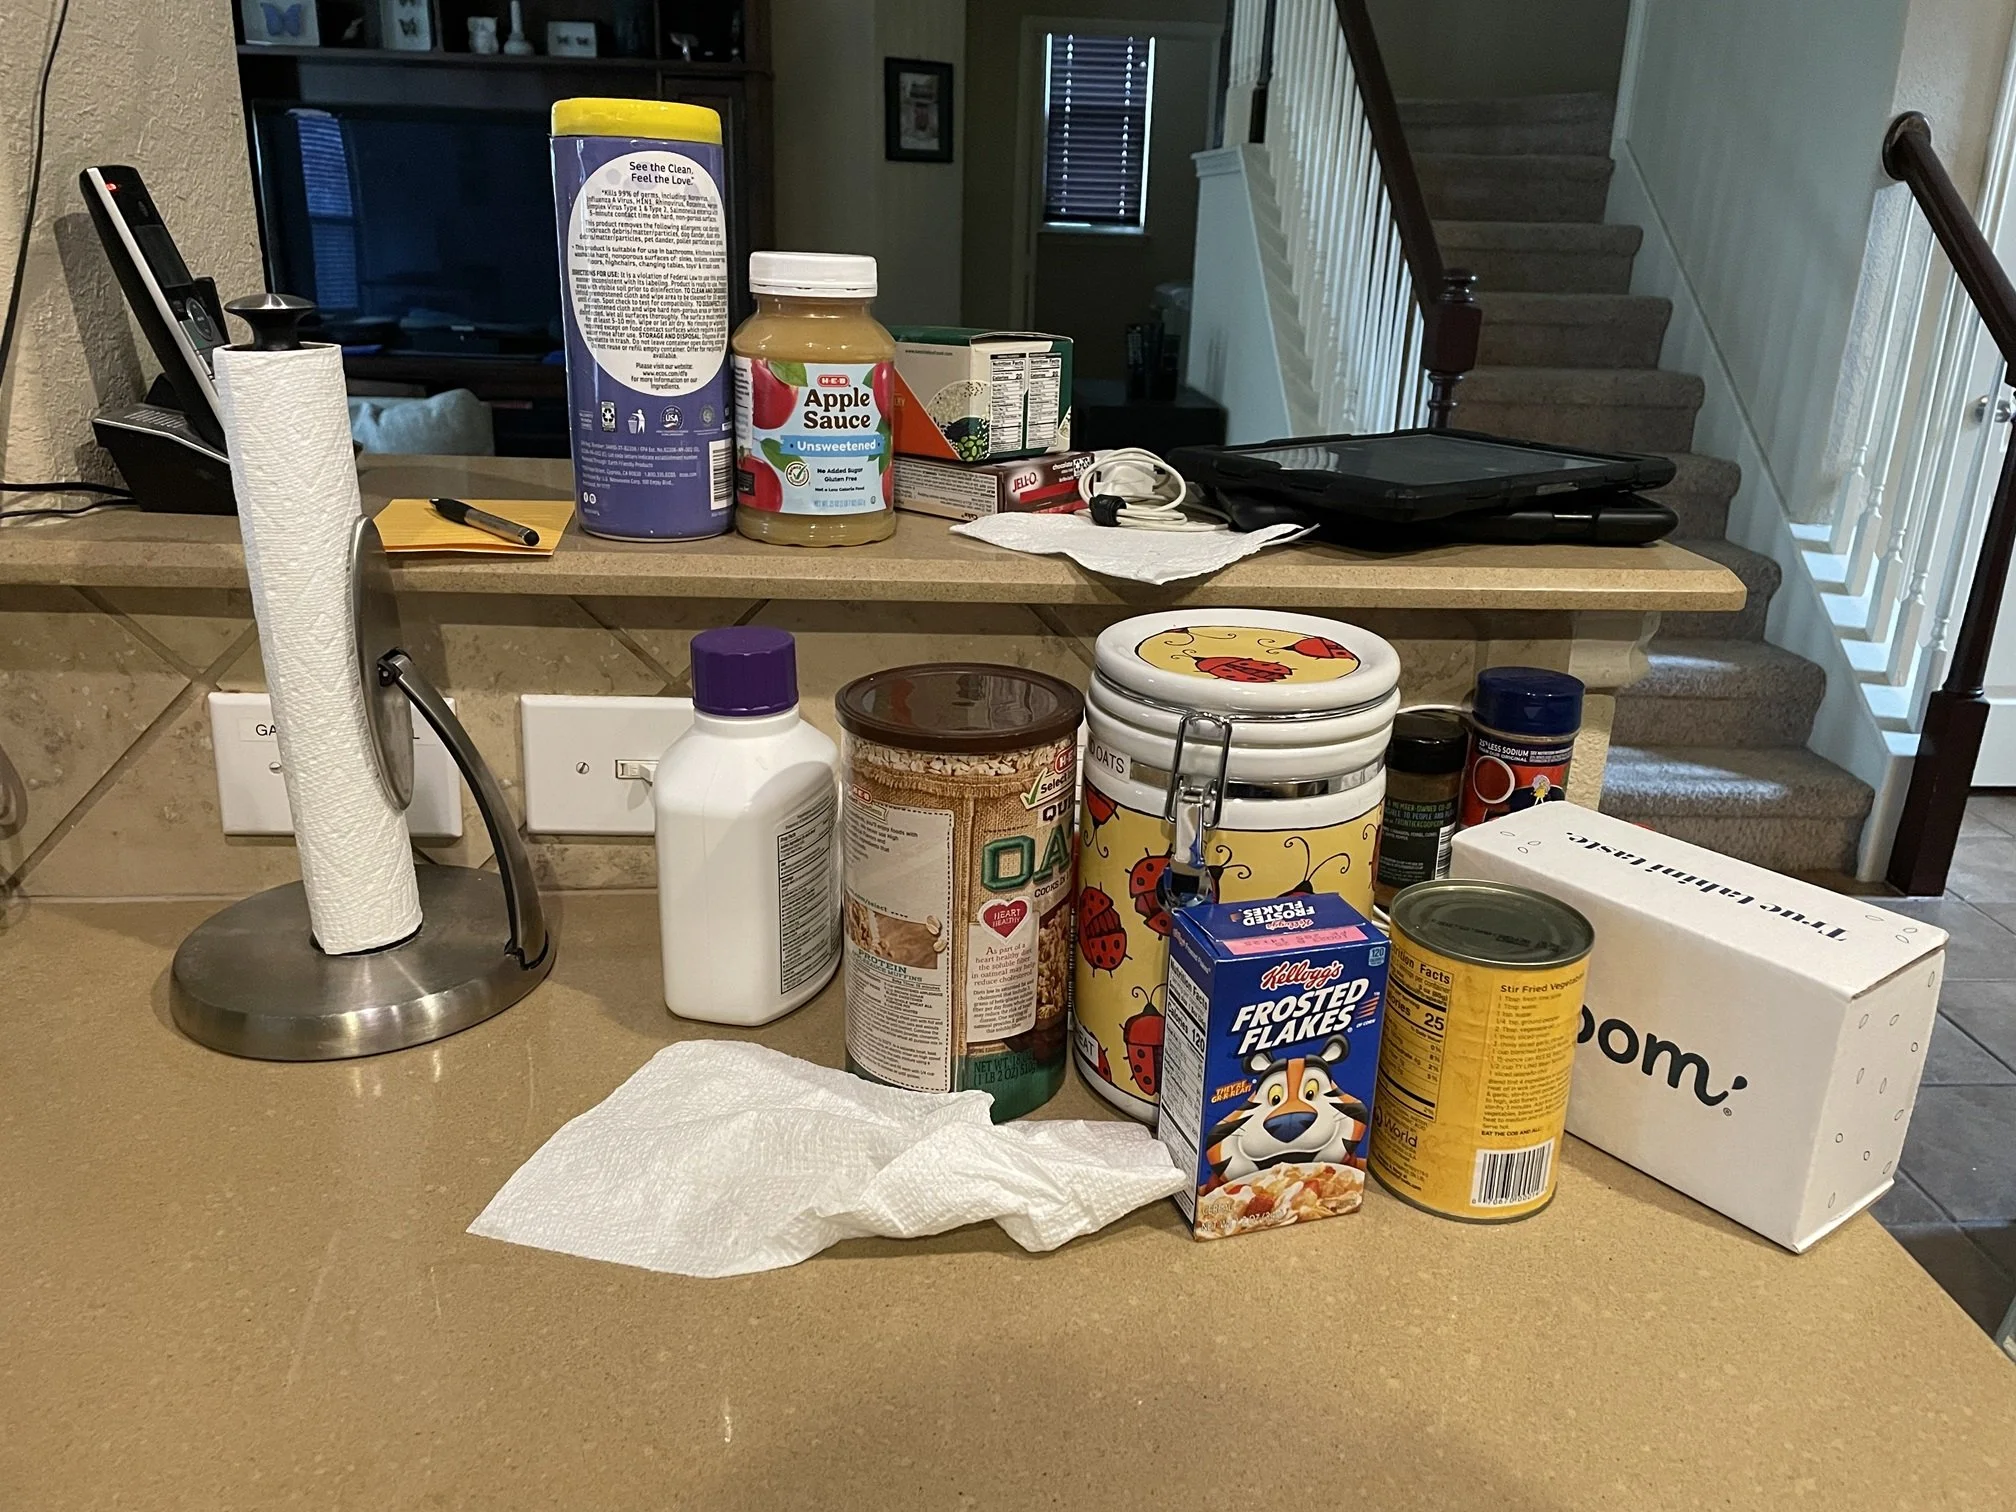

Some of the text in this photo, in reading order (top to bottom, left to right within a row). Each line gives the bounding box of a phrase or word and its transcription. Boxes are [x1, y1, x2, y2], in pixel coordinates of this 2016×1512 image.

[629, 161, 648, 171] See
[650, 163, 666, 173] the
[631, 173, 652, 183] Feel
[654, 175, 670, 184] the
[618, 190, 631, 198] 99%
[632, 190, 640, 198] of
[624, 204, 662, 214] Type Type
[654, 223, 679, 231] following
[645, 236, 655, 244] pet
[606, 244, 611, 252] is
[644, 254, 669, 262] surfaces
[636, 272, 662, 280] violation
[638, 332, 676, 340] STORAGE AND
[636, 362, 653, 370] Please
[804, 387, 870, 413] Apple
[665, 414, 679, 423] USA
[804, 411, 871, 430] Sauce
[797, 438, 876, 452] Unsweetened
[1012, 472, 1037, 492] JELL-O
[1488, 742, 1501, 753] LESS
[1502, 746, 1529, 757] SODIUM
[1096, 745, 1125, 774] OATS
[1501, 754, 1528, 763] ORIGINAL
[1040, 773, 1068, 794] Select
[1566, 832, 1848, 942] True tahini taste.
[994, 908, 1021, 921] HEART
[1243, 900, 1304, 919] FLAKES
[992, 916, 1021, 928] HEALTHY
[1242, 906, 1316, 927] FROSTED
[1266, 918, 1314, 931] Kellogg's
[986, 946, 998, 955] As
[999, 945, 1013, 955] part
[1372, 947, 1385, 958] 120
[858, 948, 908, 974] PROTEIN
[976, 955, 995, 964] heart
[996, 952, 1019, 961] healthy
[992, 960, 1016, 970] soluble
[1017, 956, 1031, 965] fiber
[980, 968, 1008, 978] oatmeal
[1009, 965, 1023, 974] may
[1024, 962, 1036, 970] help
[1260, 959, 1344, 991] Kellogg's
[1420, 963, 1450, 985] Facts
[974, 978, 998, 986] reduce
[1500, 984, 1520, 993] Stir
[1522, 984, 1548, 993] Fried
[1193, 985, 1208, 1011] Facts
[1231, 978, 1369, 1033] FROSTED
[1168, 1002, 1205, 1053] Calories 120
[1424, 1012, 1445, 1031] 25
[1238, 1004, 1356, 1055] FLAKES
[974, 1060, 992, 1073] NET
[985, 1070, 996, 1084] LB
[998, 1070, 1003, 1082] 2
[1384, 1115, 1418, 1148] World
[1202, 1203, 1233, 1216] CEREAL
